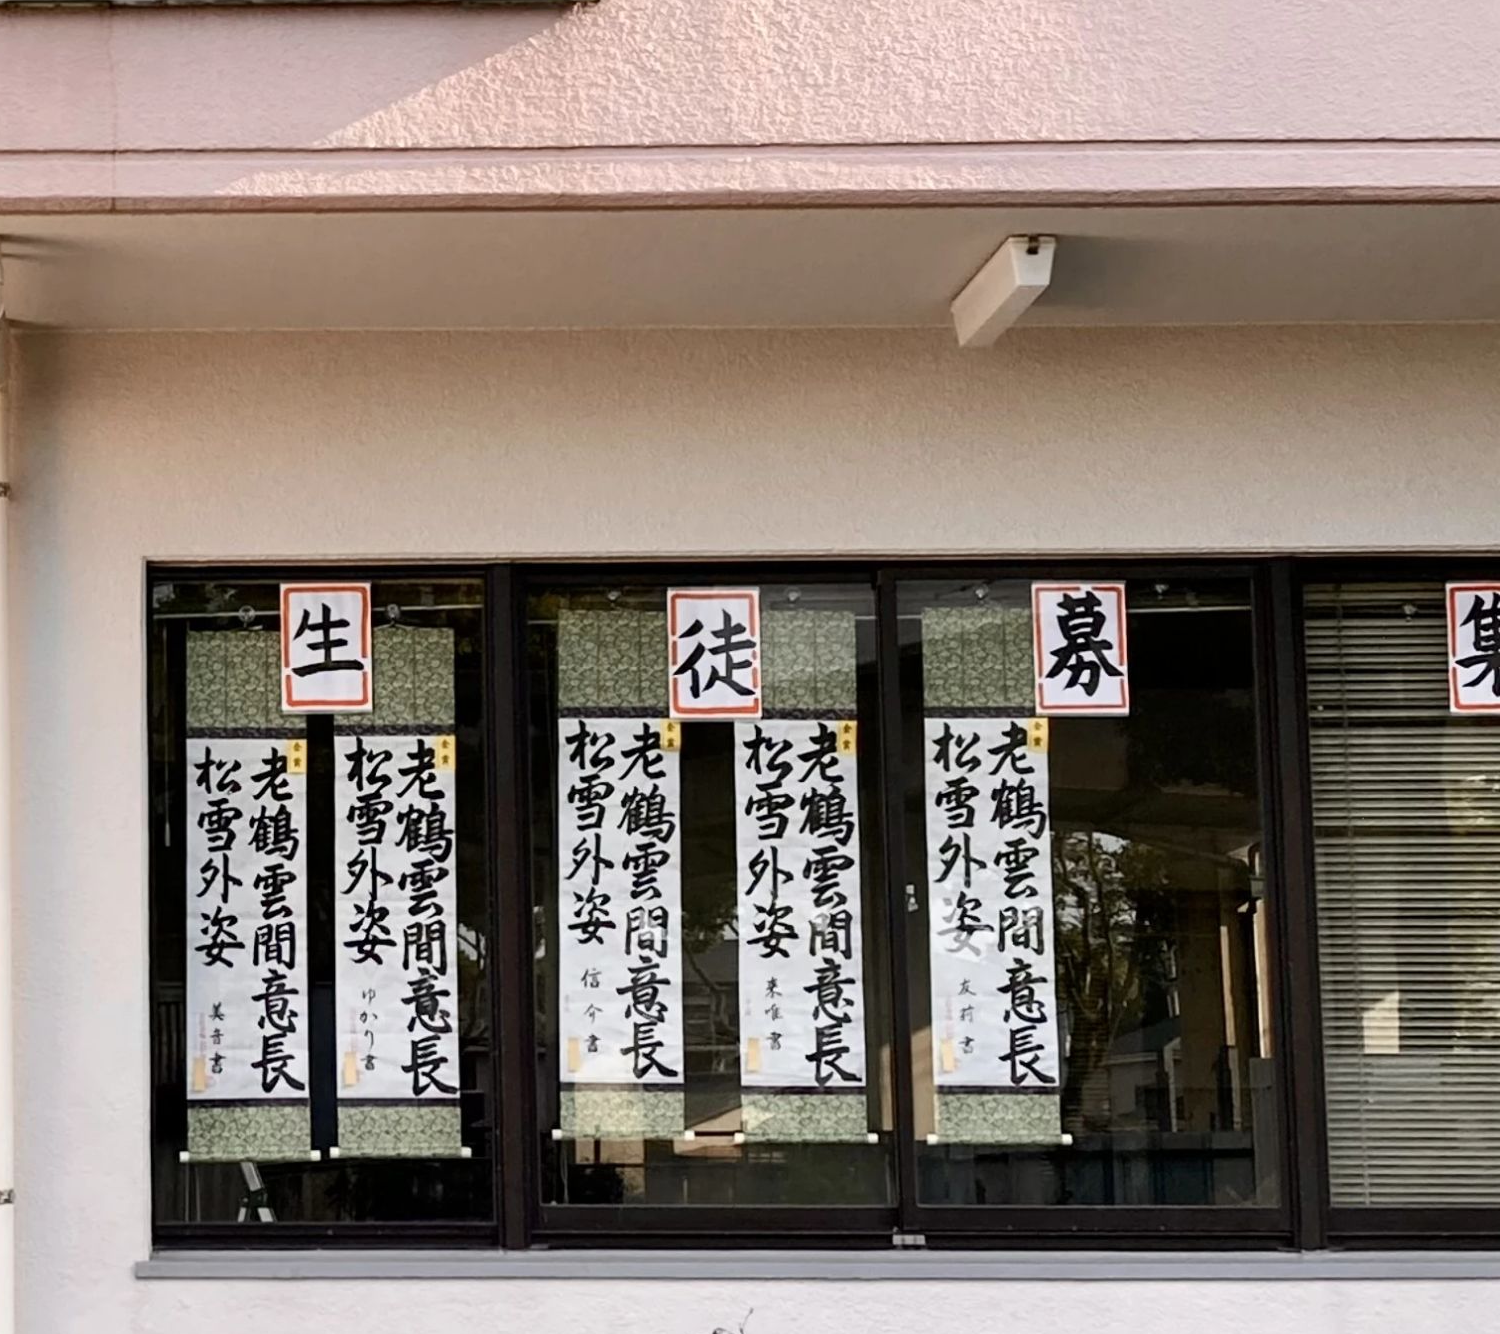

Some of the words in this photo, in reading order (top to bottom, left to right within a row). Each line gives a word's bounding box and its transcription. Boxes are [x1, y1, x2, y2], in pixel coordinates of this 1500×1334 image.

[289, 602, 366, 679] 生
[671, 608, 757, 699] 徒
[1044, 590, 1126, 697] 募
[194, 746, 246, 970] 松雪外姿
[341, 737, 398, 968] 松雪外姿
[564, 721, 617, 947] 松雪外姿
[743, 724, 800, 960] 松雪外姿
[932, 724, 994, 957] 松雪外姿
[359, 988, 378, 1072] ゆかり書
[581, 967, 603, 1053] 信介書
